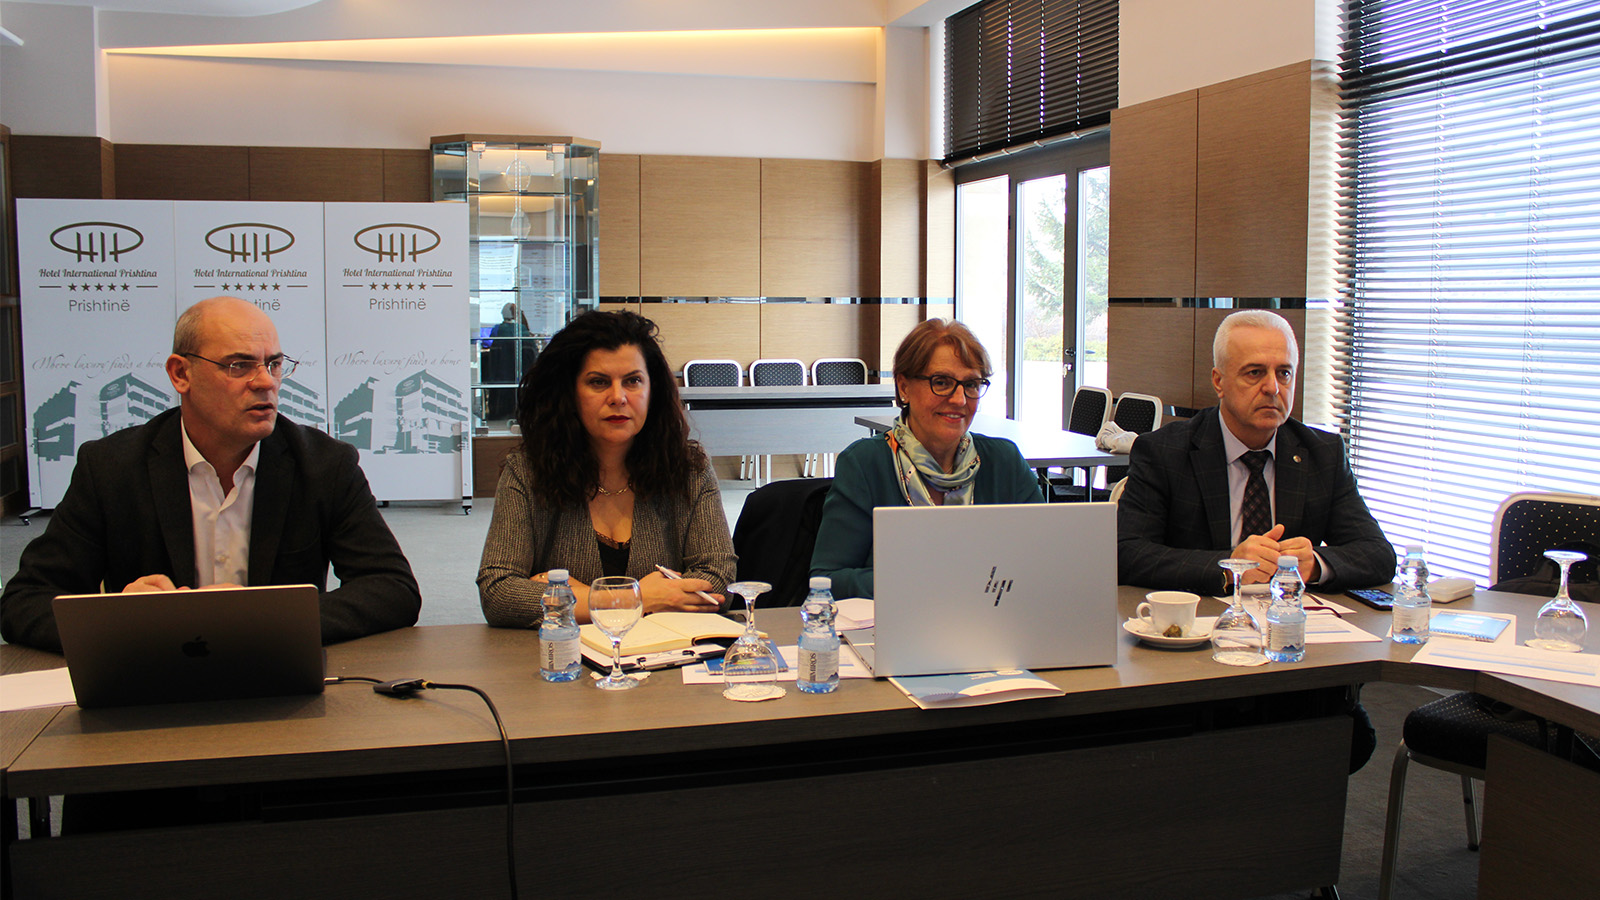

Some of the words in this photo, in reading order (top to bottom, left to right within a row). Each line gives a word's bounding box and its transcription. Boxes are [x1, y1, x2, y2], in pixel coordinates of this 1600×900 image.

[39, 268, 61, 278] Hotel
[62, 268, 117, 278] International
[119, 268, 158, 278] Prishtina
[193, 268, 215, 278] Hotel
[216, 268, 269, 278] International
[270, 268, 308, 278] Prishtina
[342, 268, 363, 278] Hotel
[364, 268, 415, 278] International
[417, 268, 453, 278] Prishtina
[68, 299, 131, 312] Prishtinë
[369, 298, 427, 311] Prishtinë
